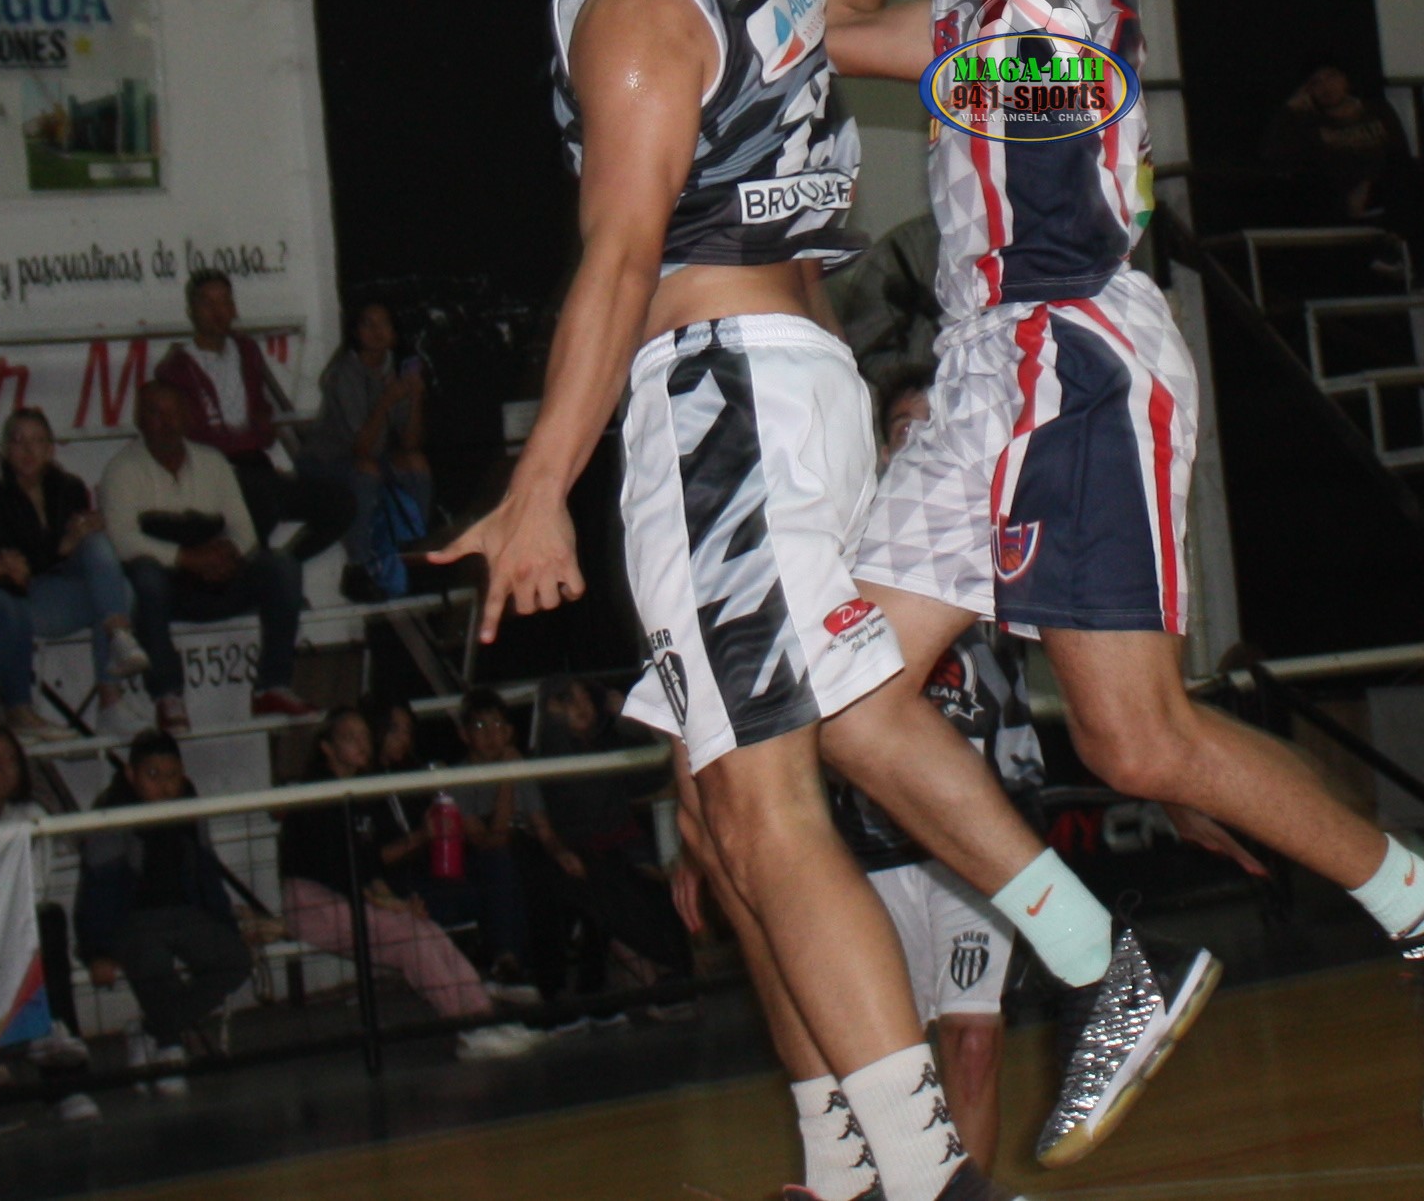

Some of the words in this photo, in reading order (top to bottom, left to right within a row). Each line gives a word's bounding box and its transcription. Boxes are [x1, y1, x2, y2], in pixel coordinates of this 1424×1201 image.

[0, 261, 13, 300] y
[18, 243, 143, 302] pascualinas
[152, 239, 176, 279] de
